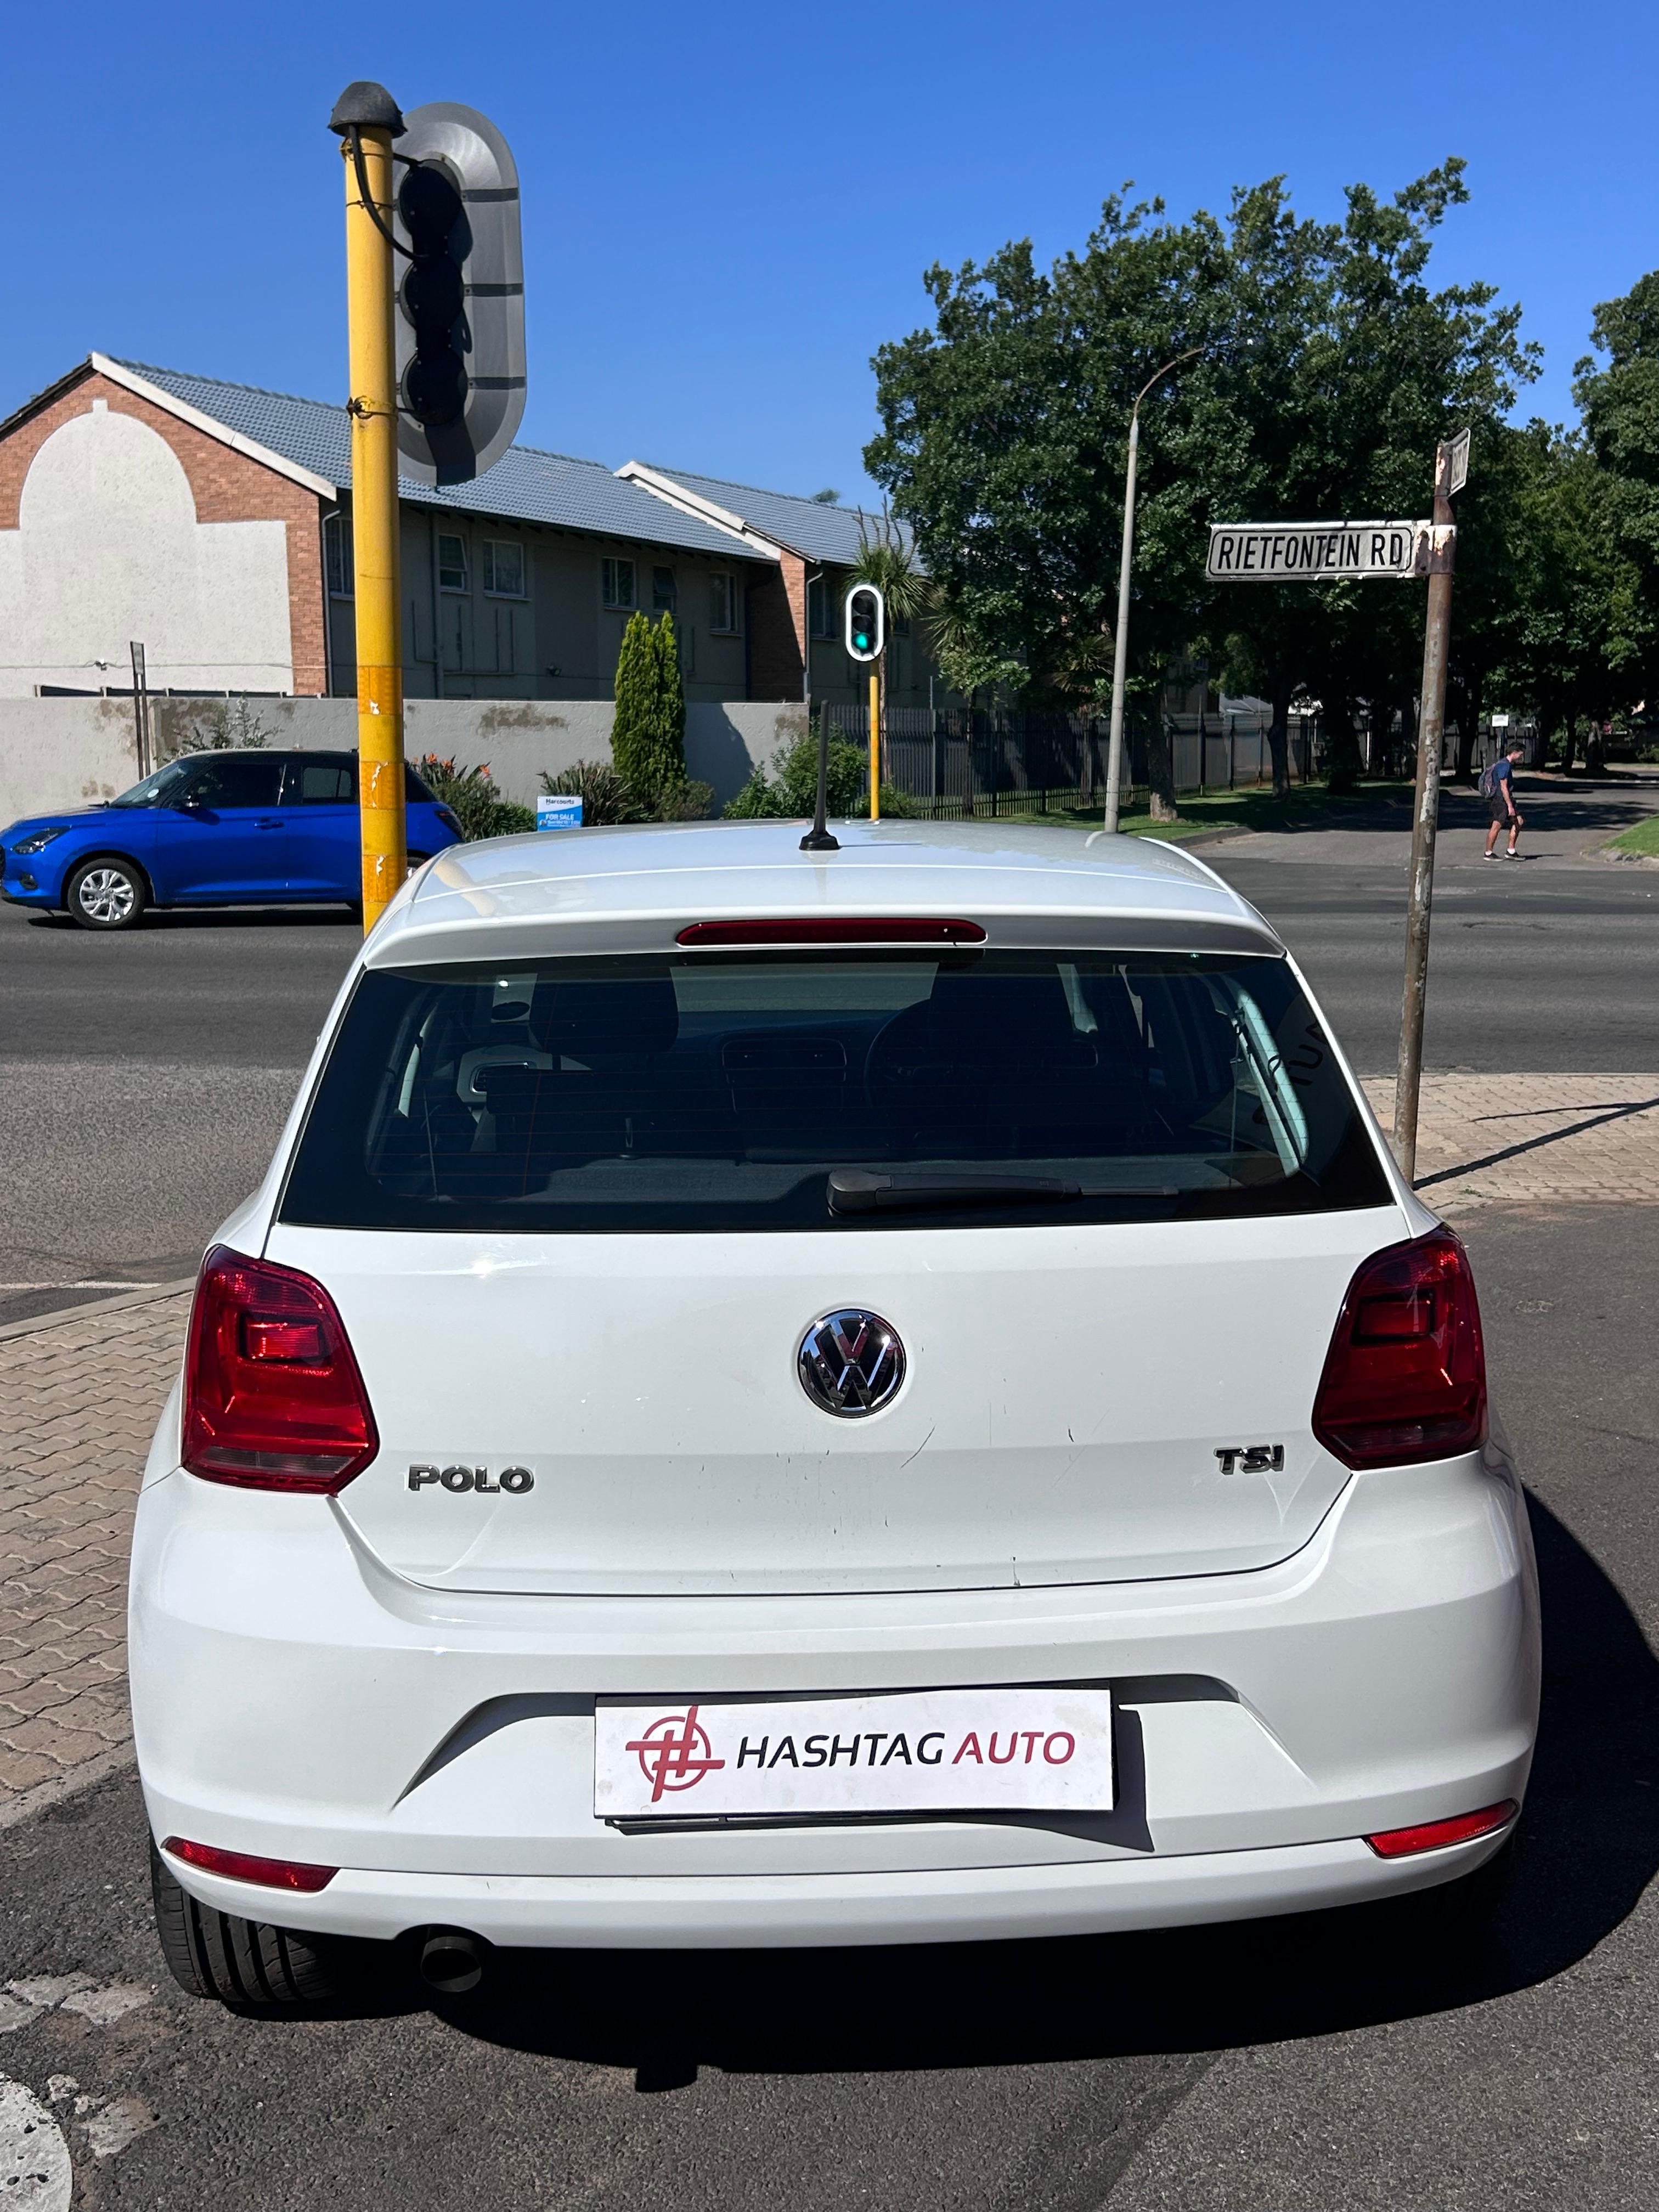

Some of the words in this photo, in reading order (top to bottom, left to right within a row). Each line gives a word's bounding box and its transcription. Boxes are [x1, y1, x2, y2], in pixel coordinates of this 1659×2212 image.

[1217, 534, 1361, 569] RIETFONTEIN
[1371, 533, 1403, 567] RD
[801, 1312, 902, 1413] VW
[1214, 1443, 1285, 1476] TSI
[408, 1463, 535, 1494] POLO
[737, 1732, 945, 1769] HASHTAG
[952, 1731, 1076, 1765] AUTO
